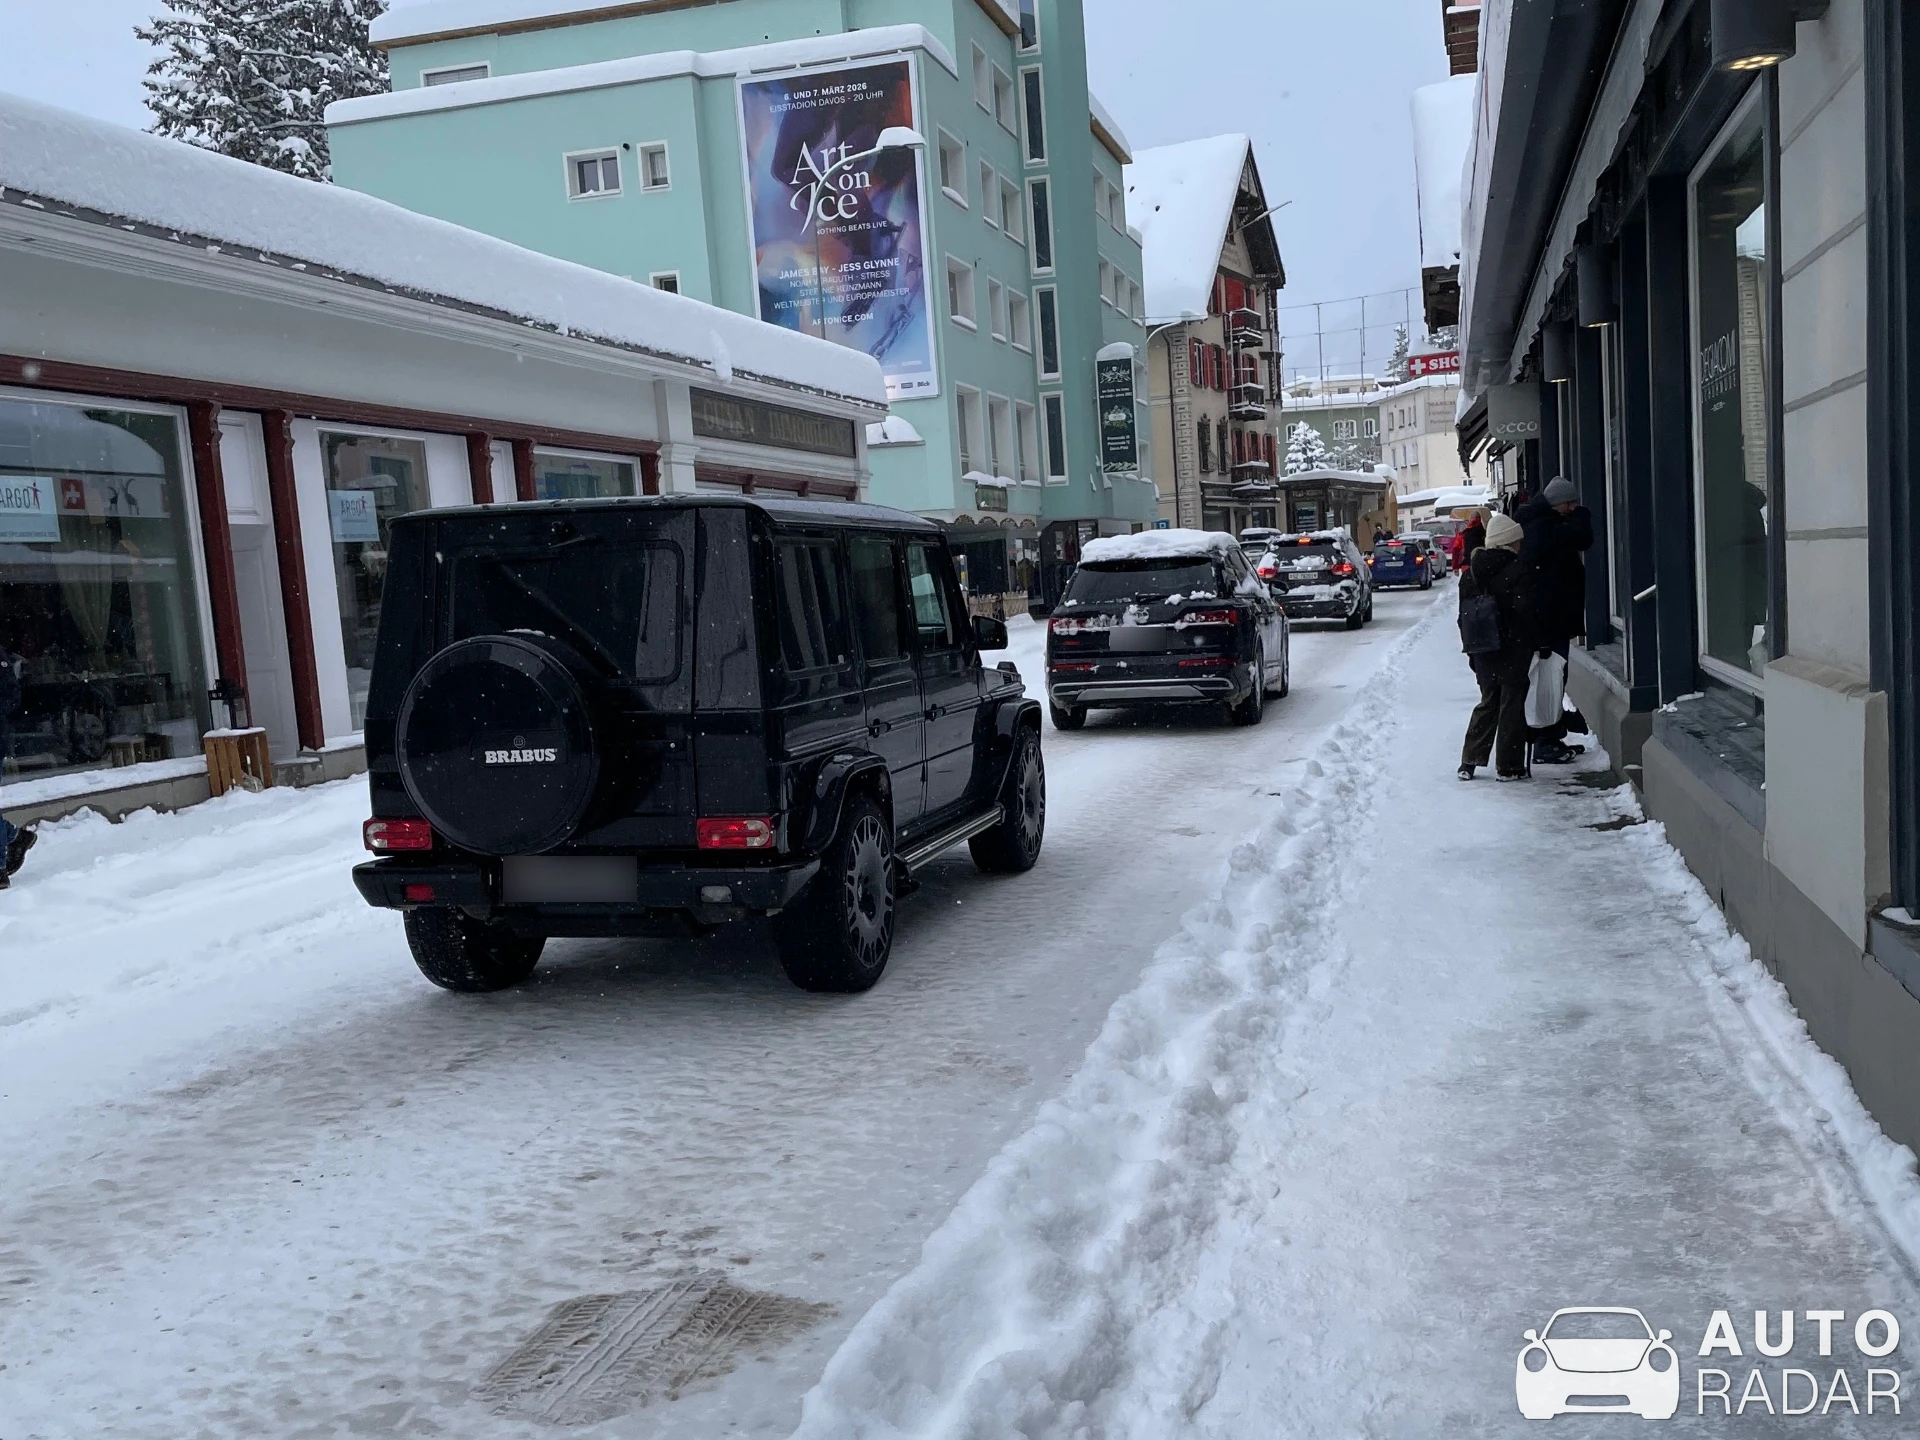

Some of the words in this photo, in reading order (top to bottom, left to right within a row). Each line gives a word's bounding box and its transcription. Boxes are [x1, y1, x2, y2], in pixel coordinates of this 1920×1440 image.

[793, 89, 812, 100] UND
[813, 88, 820, 98] 7.
[821, 85, 845, 96] MÄRZ
[847, 82, 868, 92] 2026
[769, 99, 817, 113] EISSTADION
[818, 95, 846, 107] DAVOS
[853, 92, 865, 102] 20
[866, 90, 884, 100] UHR
[789, 140, 855, 194] Art
[838, 170, 873, 191] on
[790, 181, 859, 236] Ice
[848, 221, 871, 232] BEATS
[872, 220, 888, 229] LIVE
[778, 267, 810, 280] JAMES
[838, 261, 861, 274] JESS
[863, 257, 900, 270] GLYNNE
[860, 269, 891, 279] STRESS
[827, 294, 845, 305] UND
[845, 287, 911, 303] EUROPAMEISTER
[1496, 420, 1538, 434] ecco
[484, 748, 557, 764] BRABUS
